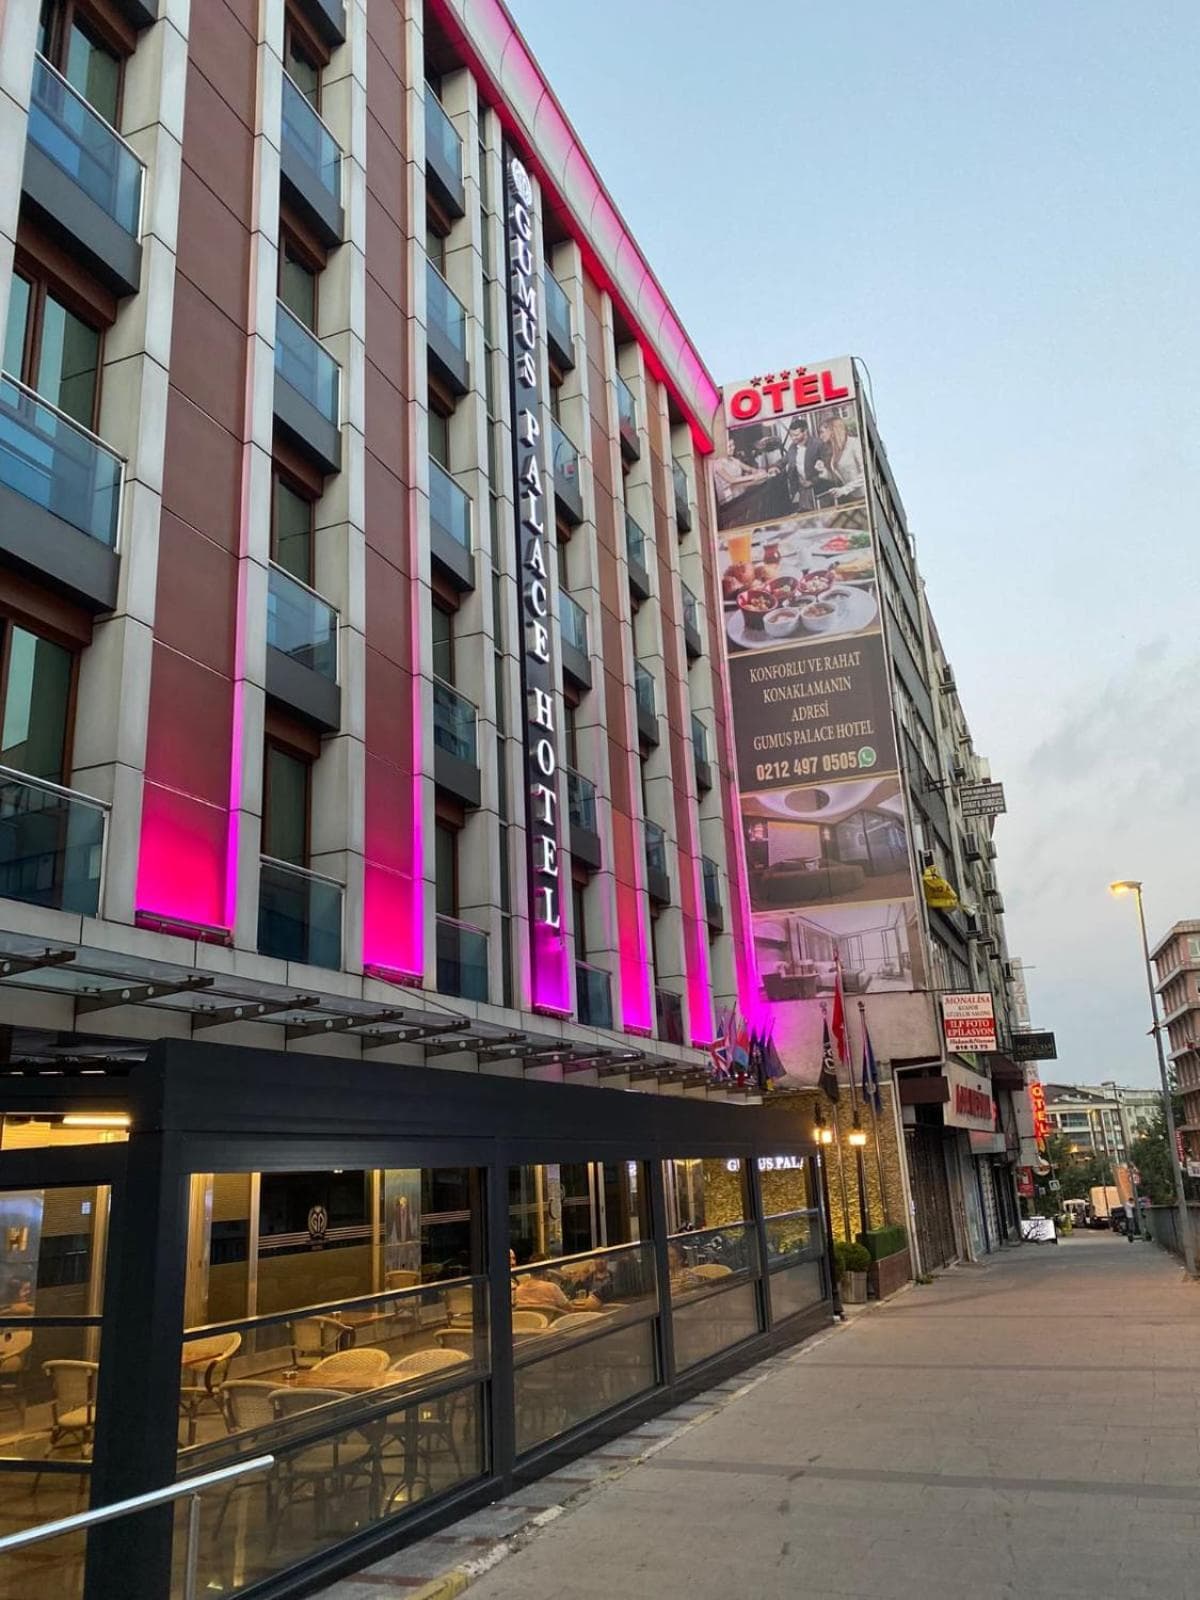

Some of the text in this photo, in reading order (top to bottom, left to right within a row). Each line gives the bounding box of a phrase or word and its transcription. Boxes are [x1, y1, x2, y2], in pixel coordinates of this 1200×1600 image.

[730, 370, 849, 420] OTEL
[522, 407, 550, 664] PALACE
[750, 651, 861, 683] KONFORLU VE RAHAT
[763, 676, 852, 703] KONAKLAMANIN
[791, 700, 830, 722] ADRESİ
[753, 719, 875, 751] GUMUS PALACE HOTEL
[756, 751, 857, 781] 0212 497 0505
[532, 687, 561, 929] HOTEL
